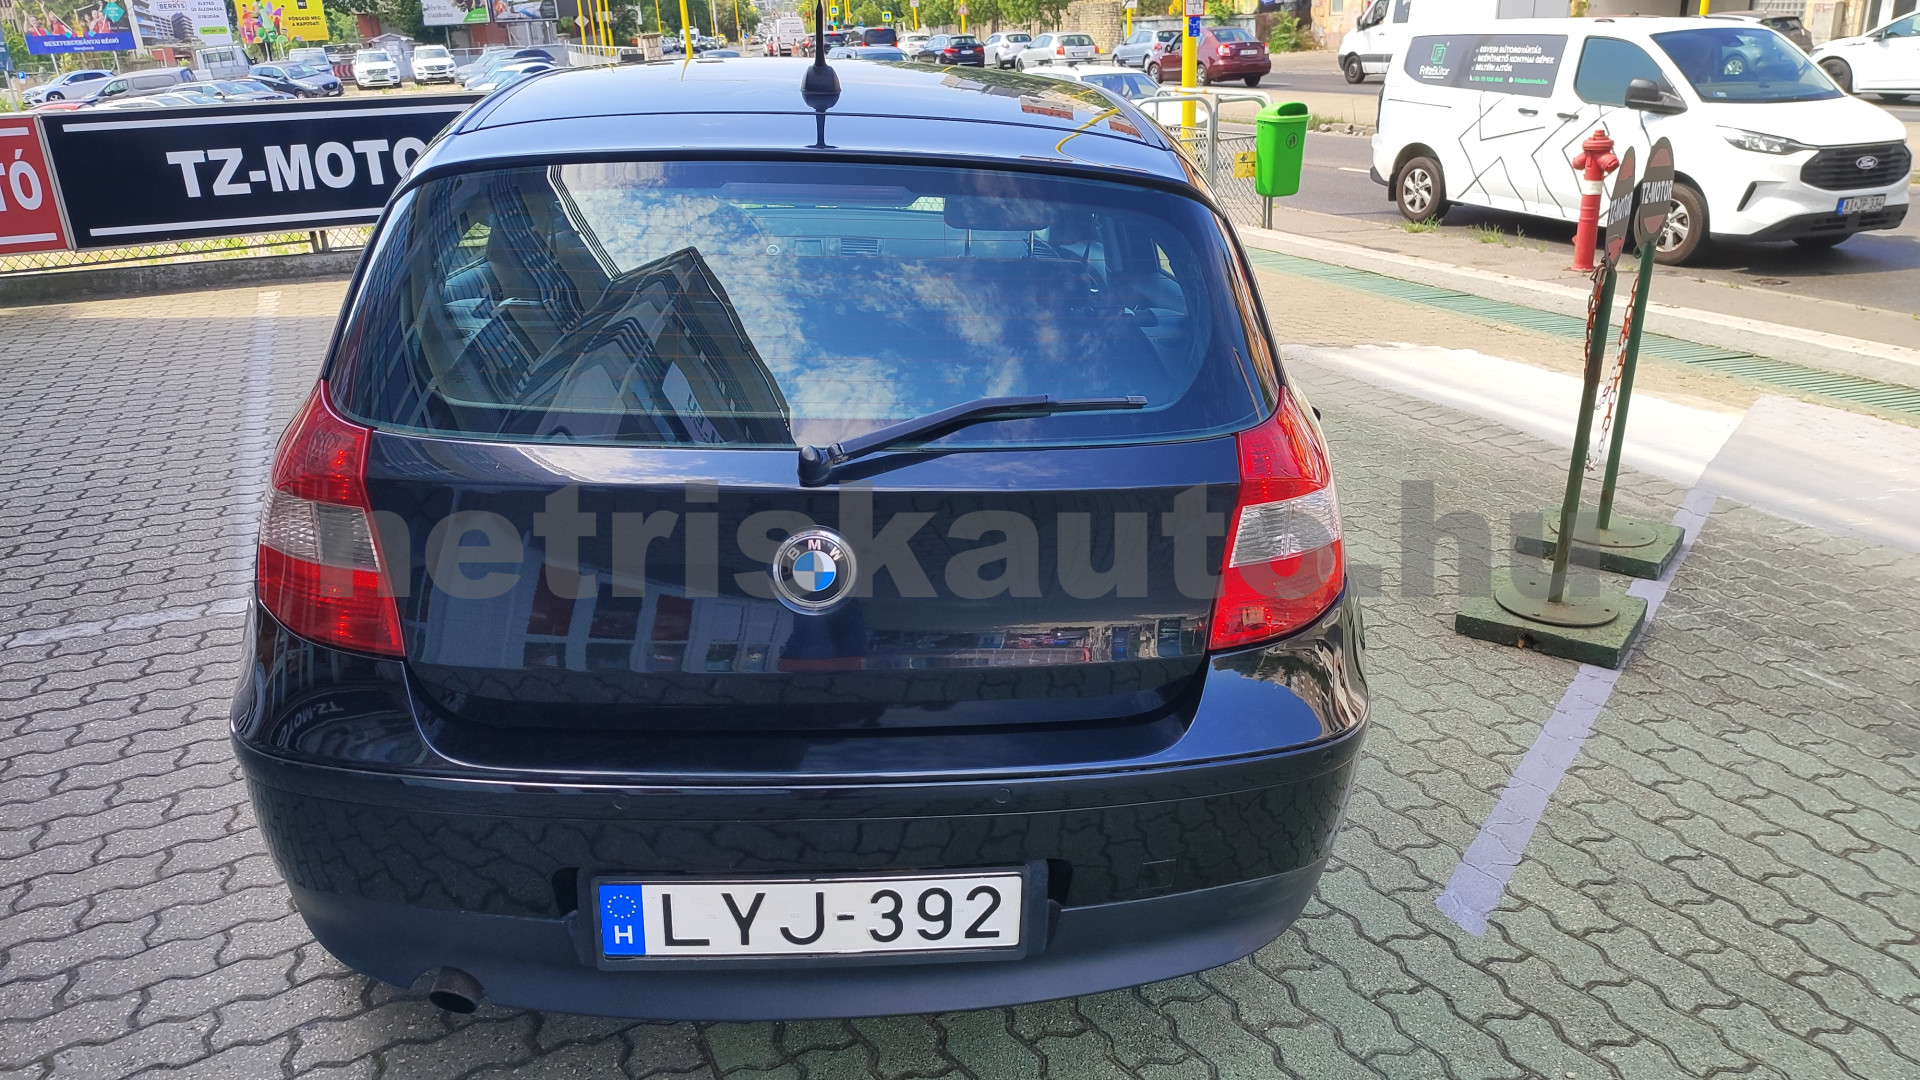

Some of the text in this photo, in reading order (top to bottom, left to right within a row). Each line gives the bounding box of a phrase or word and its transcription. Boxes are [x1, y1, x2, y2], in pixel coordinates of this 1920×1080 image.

[1641, 179, 1673, 204] TZ-MOTOR
[786, 539, 844, 561] BMW
[614, 885, 1003, 947] H LYJ-392
